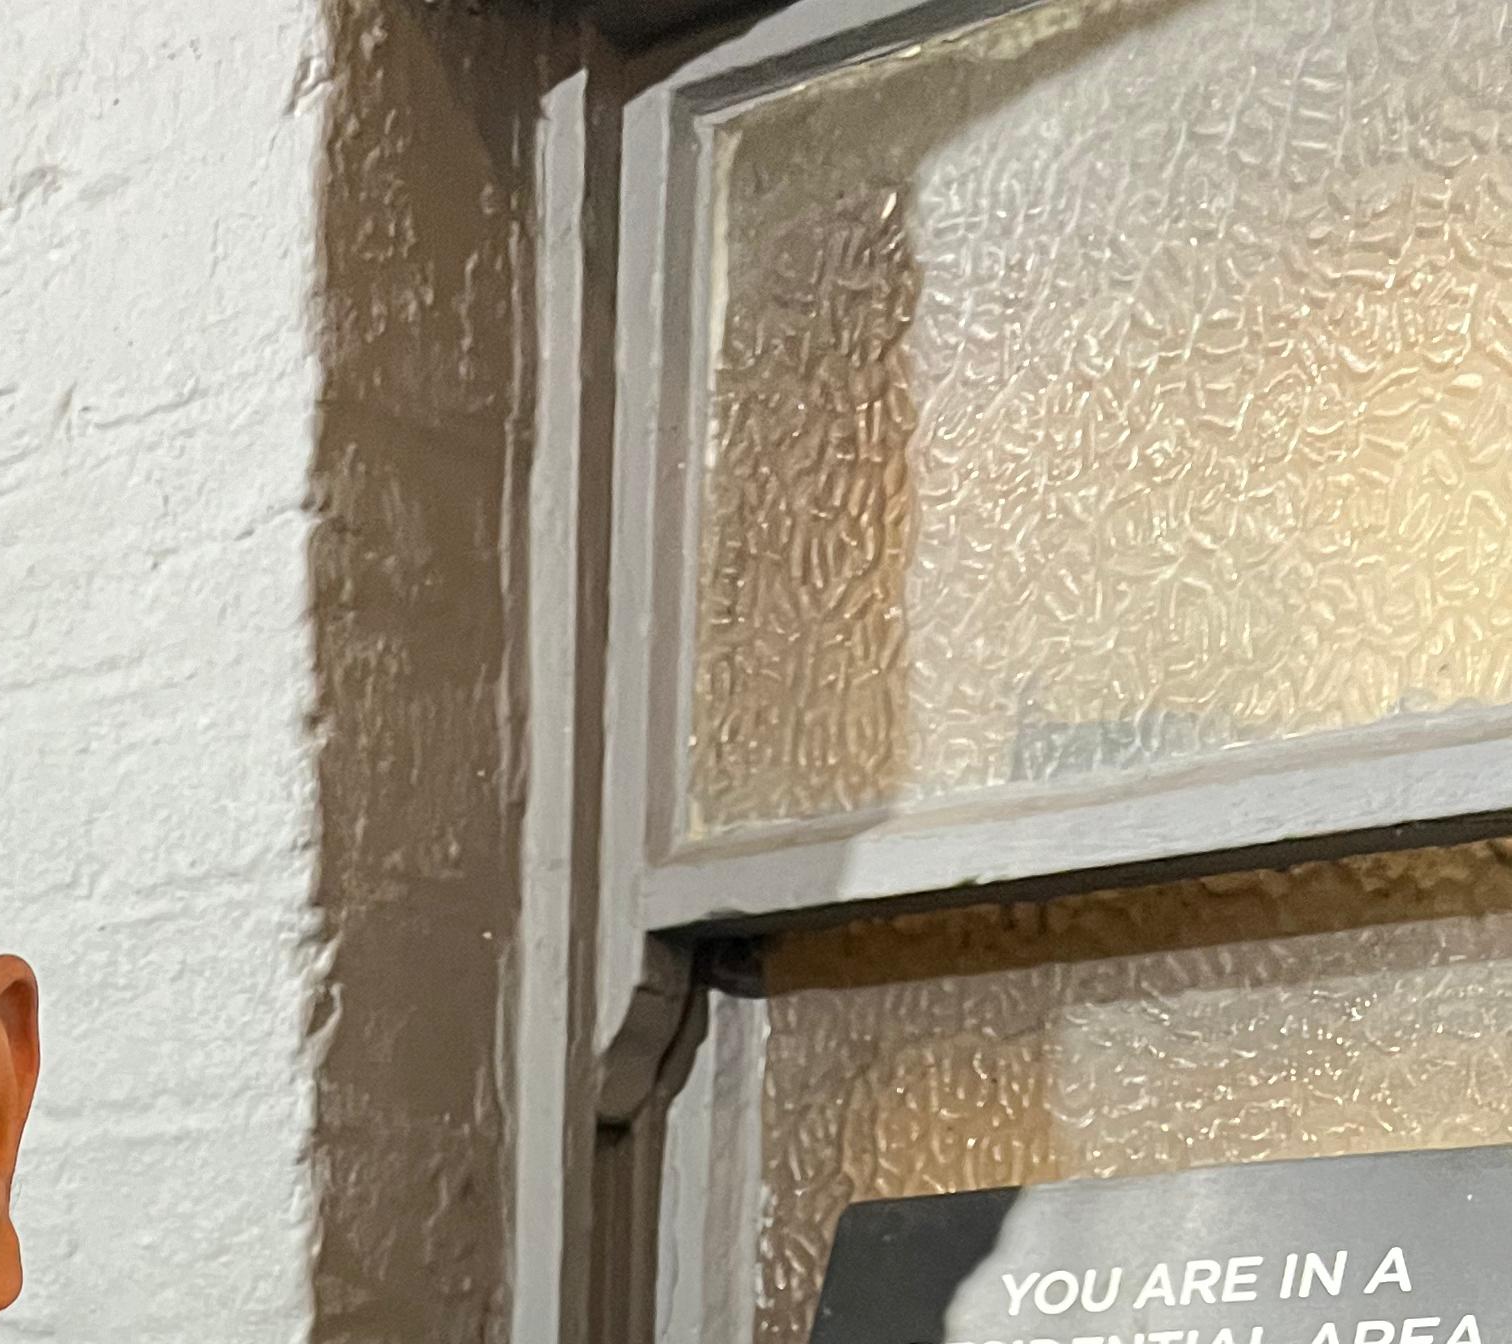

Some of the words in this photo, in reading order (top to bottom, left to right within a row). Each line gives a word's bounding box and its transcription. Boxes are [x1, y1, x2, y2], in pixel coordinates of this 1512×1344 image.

[1001, 1266, 1122, 1316] YOU
[1133, 1256, 1263, 1309] ARE
[1280, 1250, 1348, 1299] IN
[1363, 1246, 1412, 1294] A
